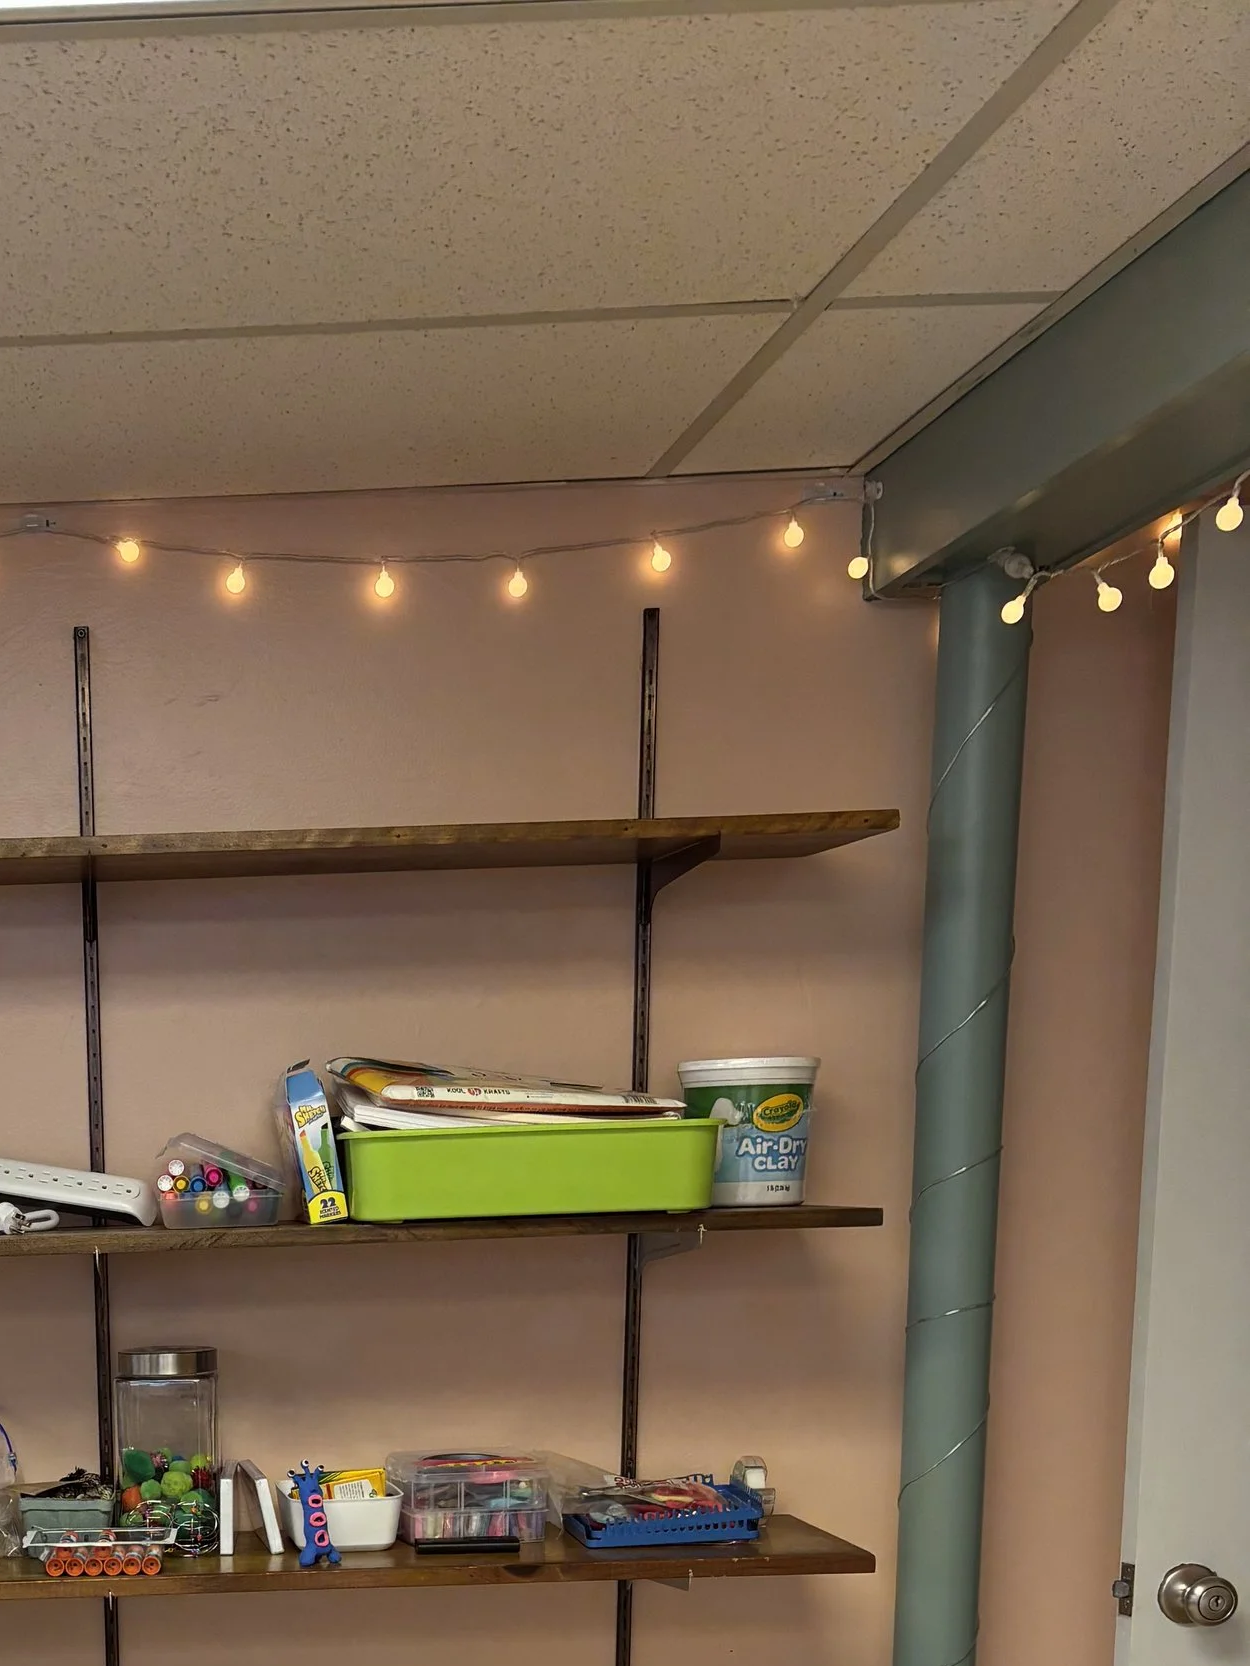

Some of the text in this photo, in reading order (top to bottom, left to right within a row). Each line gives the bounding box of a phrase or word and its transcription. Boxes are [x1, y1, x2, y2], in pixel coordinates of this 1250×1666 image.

[763, 1100, 798, 1117] Crayola
[738, 1137, 807, 1156] Air-Dry
[320, 1196, 336, 1208] 22
